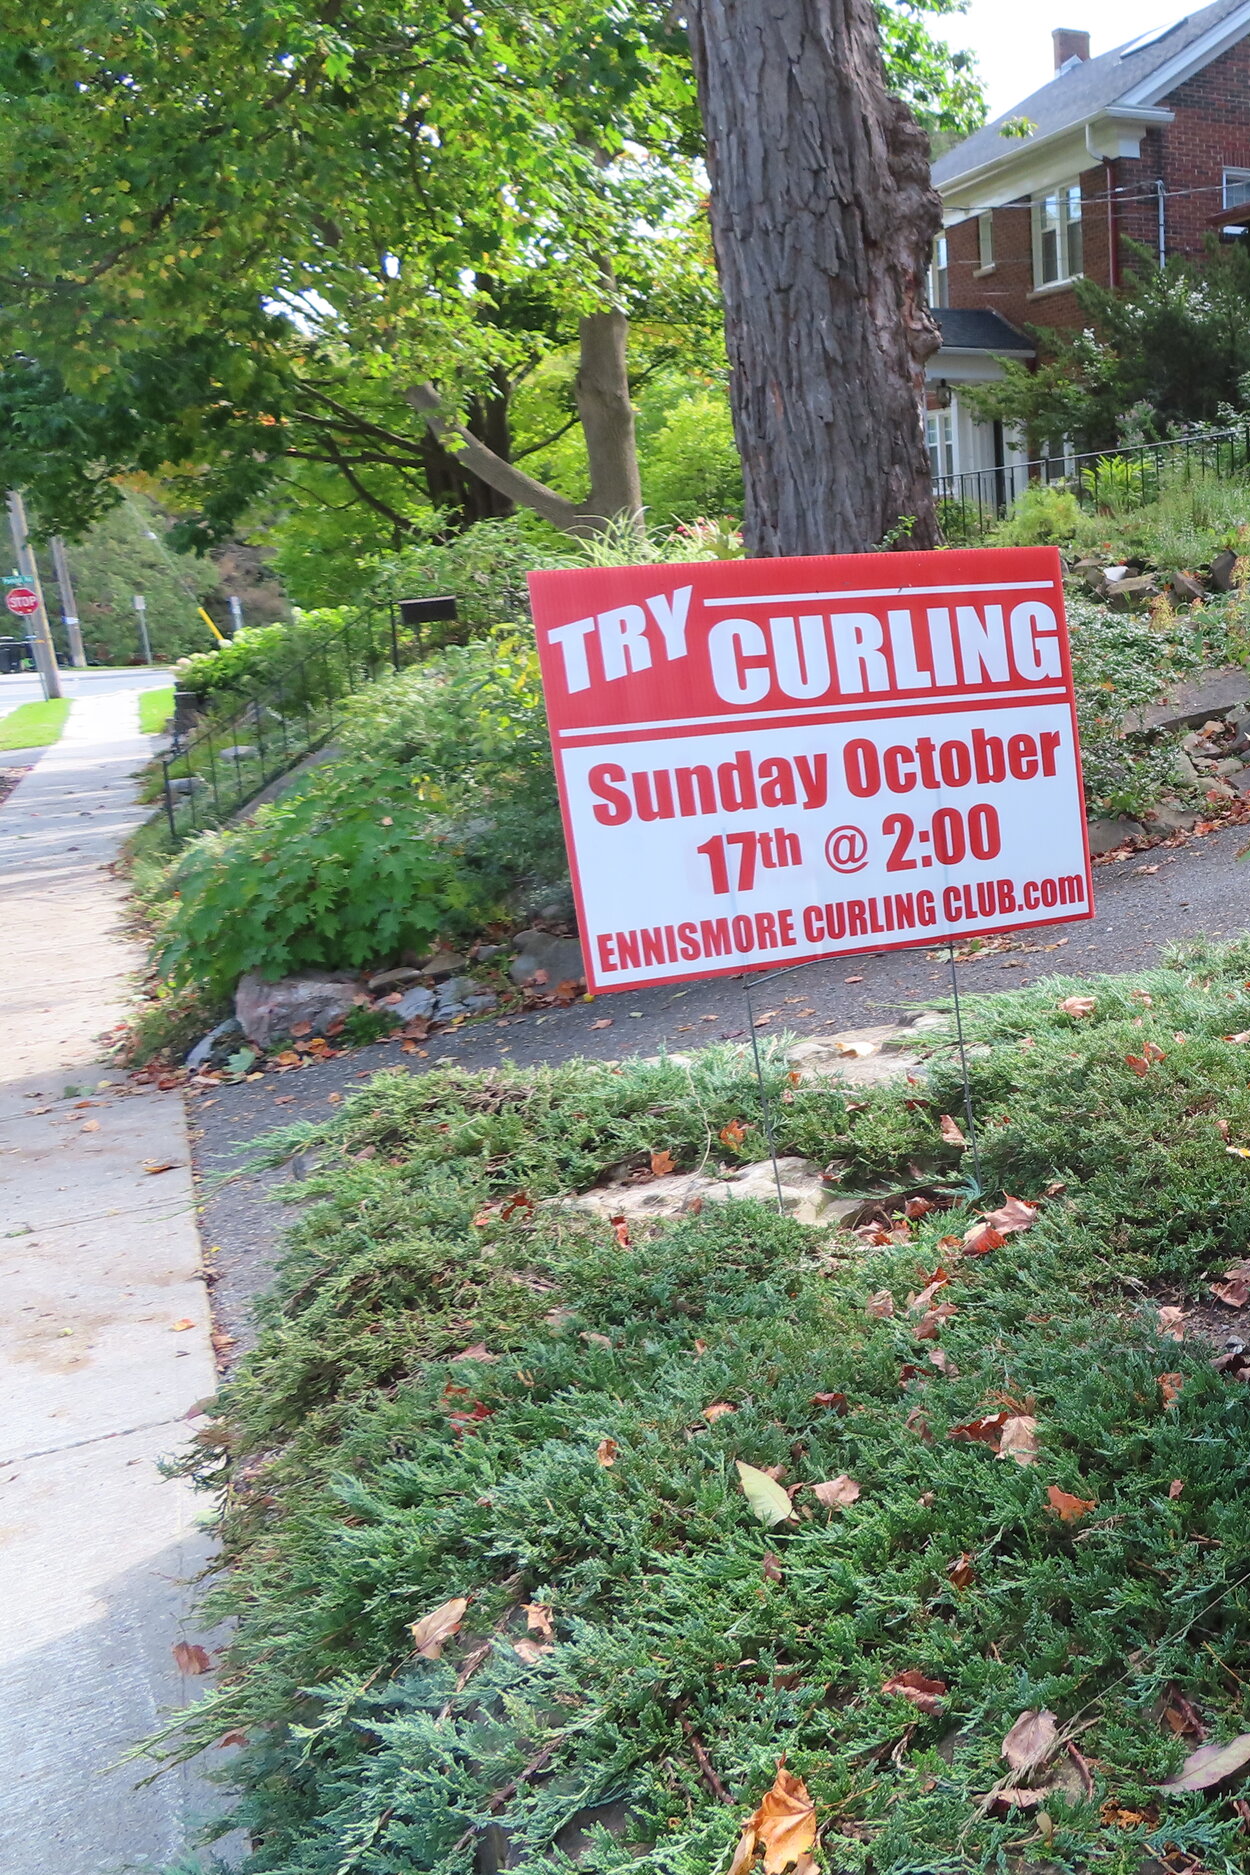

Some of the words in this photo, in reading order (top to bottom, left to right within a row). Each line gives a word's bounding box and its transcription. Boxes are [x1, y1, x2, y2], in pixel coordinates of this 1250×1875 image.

[10, 596, 36, 607] STOP
[547, 585, 693, 694] TRY
[707, 601, 1062, 705] CURLING
[588, 751, 827, 826] Sunday
[843, 728, 1061, 798] October
[697, 828, 802, 894] 17th
[825, 825, 868, 874] @
[882, 803, 1001, 872] 2:00
[597, 910, 797, 973] ENNISMORE
[803, 893, 936, 943] CURLING
[943, 874, 1085, 922] CLUB.com
